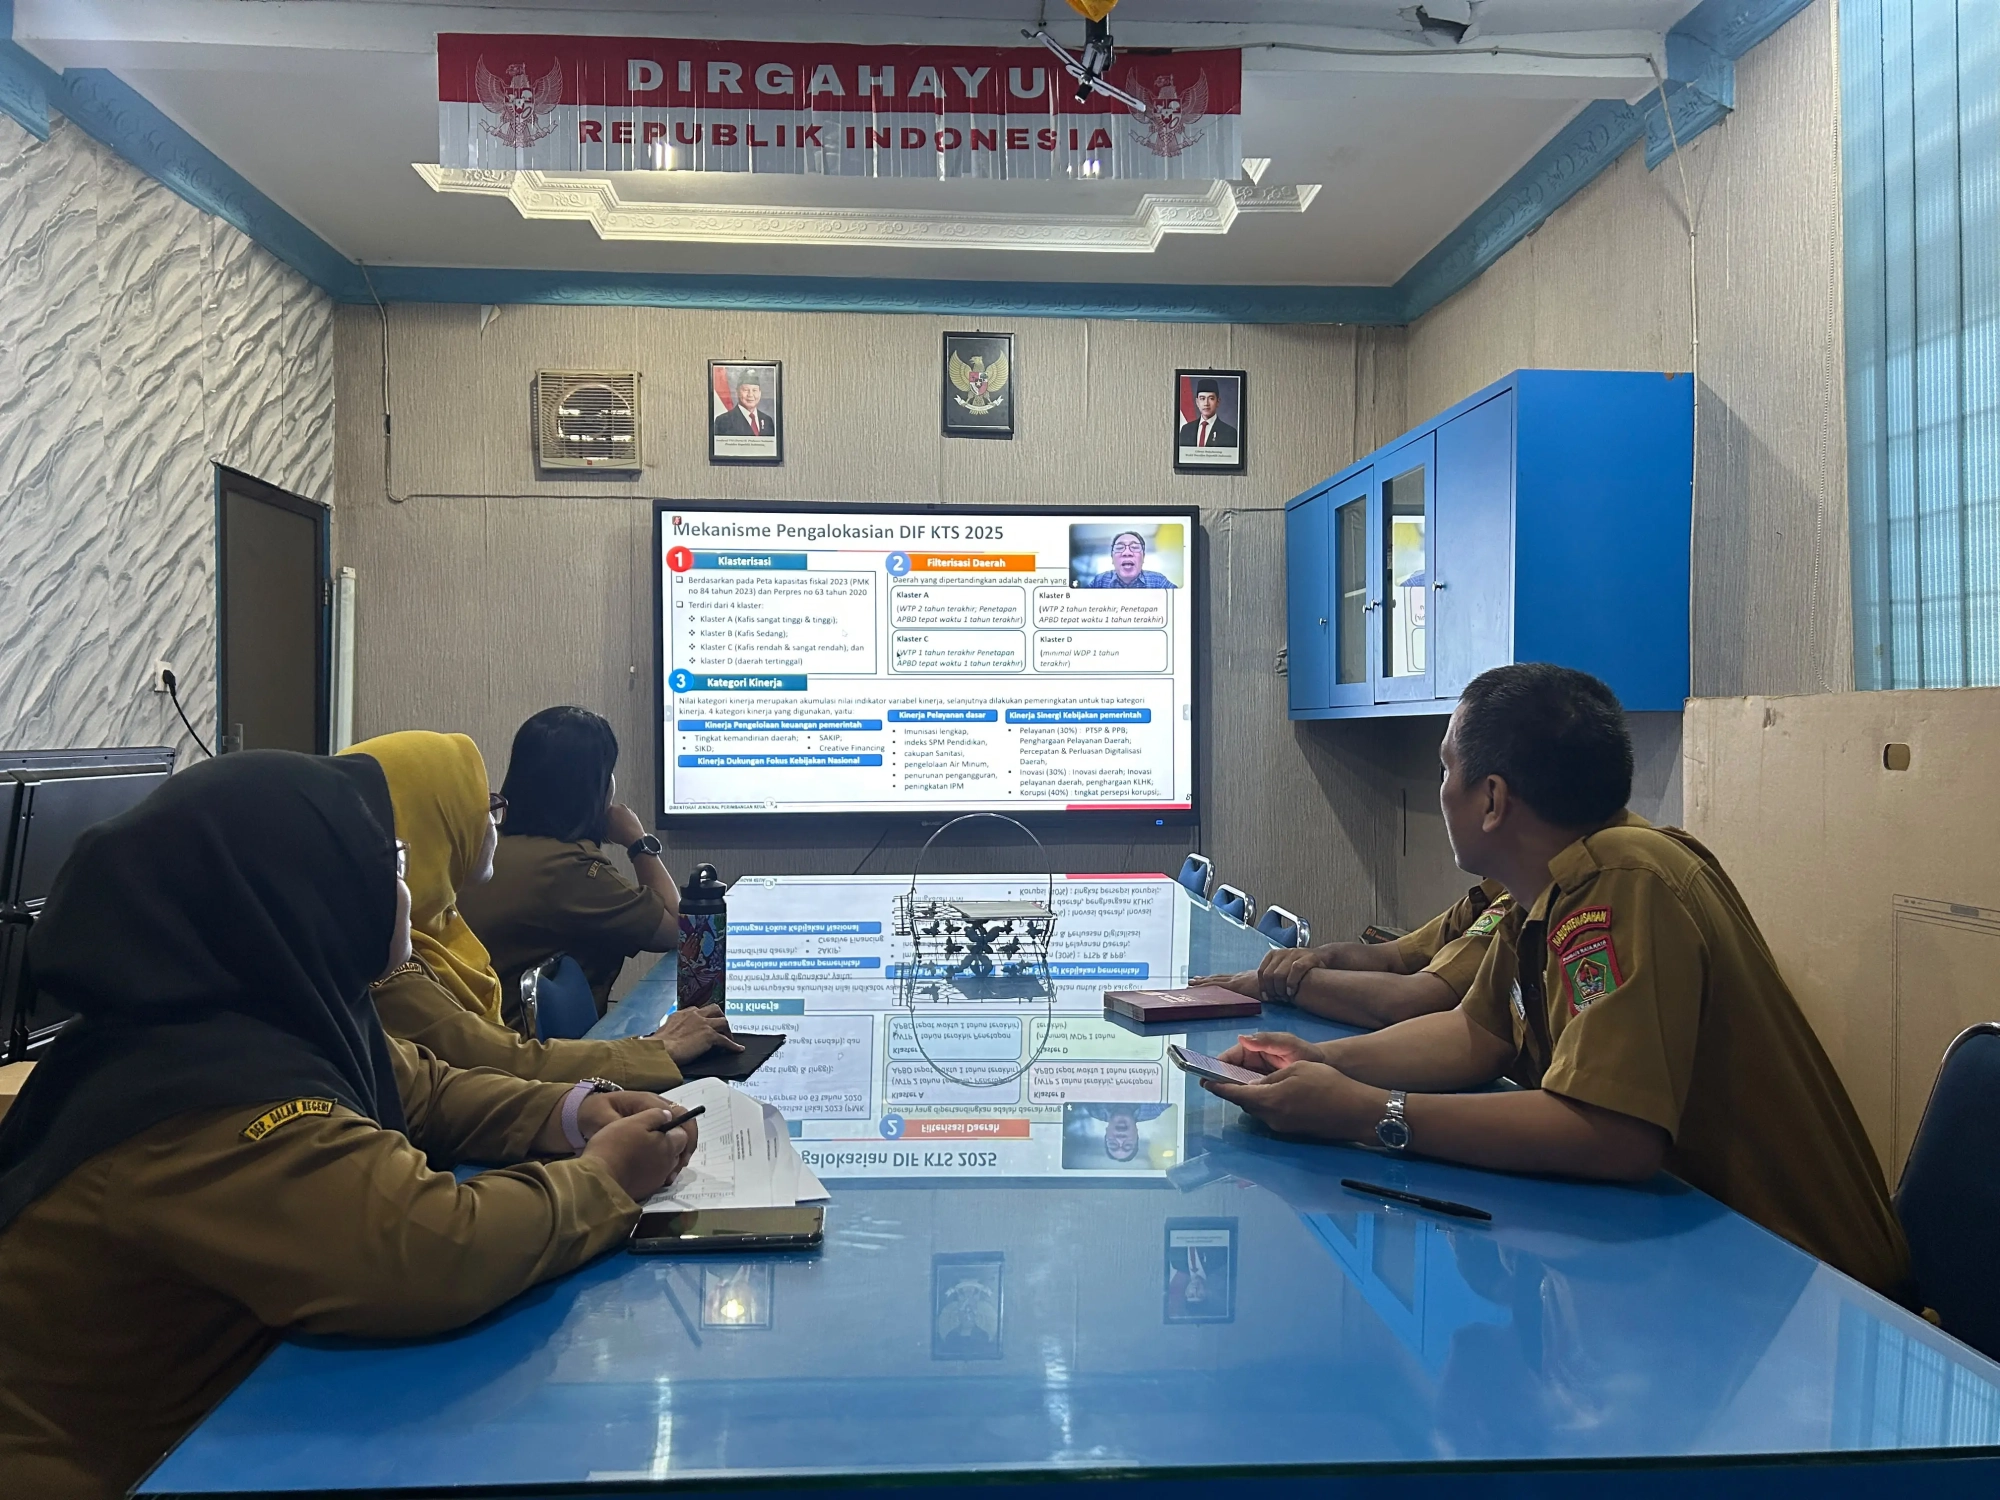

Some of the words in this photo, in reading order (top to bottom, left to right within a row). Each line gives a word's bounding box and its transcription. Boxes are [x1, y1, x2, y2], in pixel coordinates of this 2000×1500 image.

[627, 58, 1046, 99] DIRGAHAYU
[580, 120, 824, 149] REPUBLIK
[846, 125, 1113, 152] INDONESIA
[673, 522, 771, 537] Mekanisme
[777, 524, 894, 540] Pengalokasian
[900, 525, 925, 539] DIF
[931, 526, 960, 539] KTS
[965, 526, 1004, 540] 2025
[675, 552, 683, 567] 1
[718, 556, 771, 566] Klasterisasi
[893, 556, 904, 571] 2
[927, 558, 971, 567] Filterisasi
[972, 559, 1006, 567] Daerah
[736, 577, 755, 586] pada
[774, 578, 808, 586] kapasitas
[892, 576, 919, 584] Daerah
[939, 577, 997, 585] dipertandingkan
[700, 587, 710, 595] 84
[774, 588, 802, 597] Perpres
[897, 591, 922, 599] Klaster
[688, 601, 712, 609] Terdiri
[1120, 606, 1158, 614] Penetapan
[701, 657, 725, 665] klaster
[676, 673, 686, 689] 3
[707, 678, 747, 689] Kategori
[749, 678, 783, 689] Kinerja
[697, 697, 728, 706] kategori
[730, 698, 755, 706] kinerja
[947, 698, 988, 706] selanjutnya
[1024, 697, 1077, 706] pemeringkatan
[1116, 697, 1145, 706] kategori
[715, 708, 746, 716] kategori
[747, 708, 772, 716] kinerja
[899, 711, 926, 720] Kinerja
[927, 711, 964, 720] Pelayanan
[965, 711, 986, 719] dasar
[1010, 712, 1036, 720] Kinerja
[1037, 712, 1062, 720] Sinergi
[1063, 711, 1098, 720] Kebijakan
[1100, 711, 1142, 720] pemerintah
[705, 721, 732, 730] Kinerja
[733, 721, 780, 730] Pengelolaan
[781, 721, 818, 730] keuangan
[819, 721, 862, 730] pemerintah
[695, 735, 722, 743] Tingkat
[723, 734, 769, 742] kemandirian
[1020, 738, 1065, 746] Penghargaan
[1067, 737, 1103, 745] Pelayanan
[851, 745, 885, 753] Financing
[1020, 748, 1060, 756] Percepatan
[1105, 748, 1142, 756] Digitalisasi
[698, 757, 725, 766] Kinerja
[726, 757, 765, 766] Dukungan
[766, 757, 788, 765] Fokus
[789, 757, 826, 766] Kebijakan
[827, 756, 860, 764] Nasional
[904, 761, 948, 769] pengelolaan
[905, 783, 948, 791] peningkatan
[1020, 779, 1056, 787] pelayanan
[1086, 779, 1132, 787] penghargaan
[249, 1121, 272, 1138] DEP.
[270, 1101, 299, 1124] DALAM
[302, 1101, 330, 1112] NEGERI
